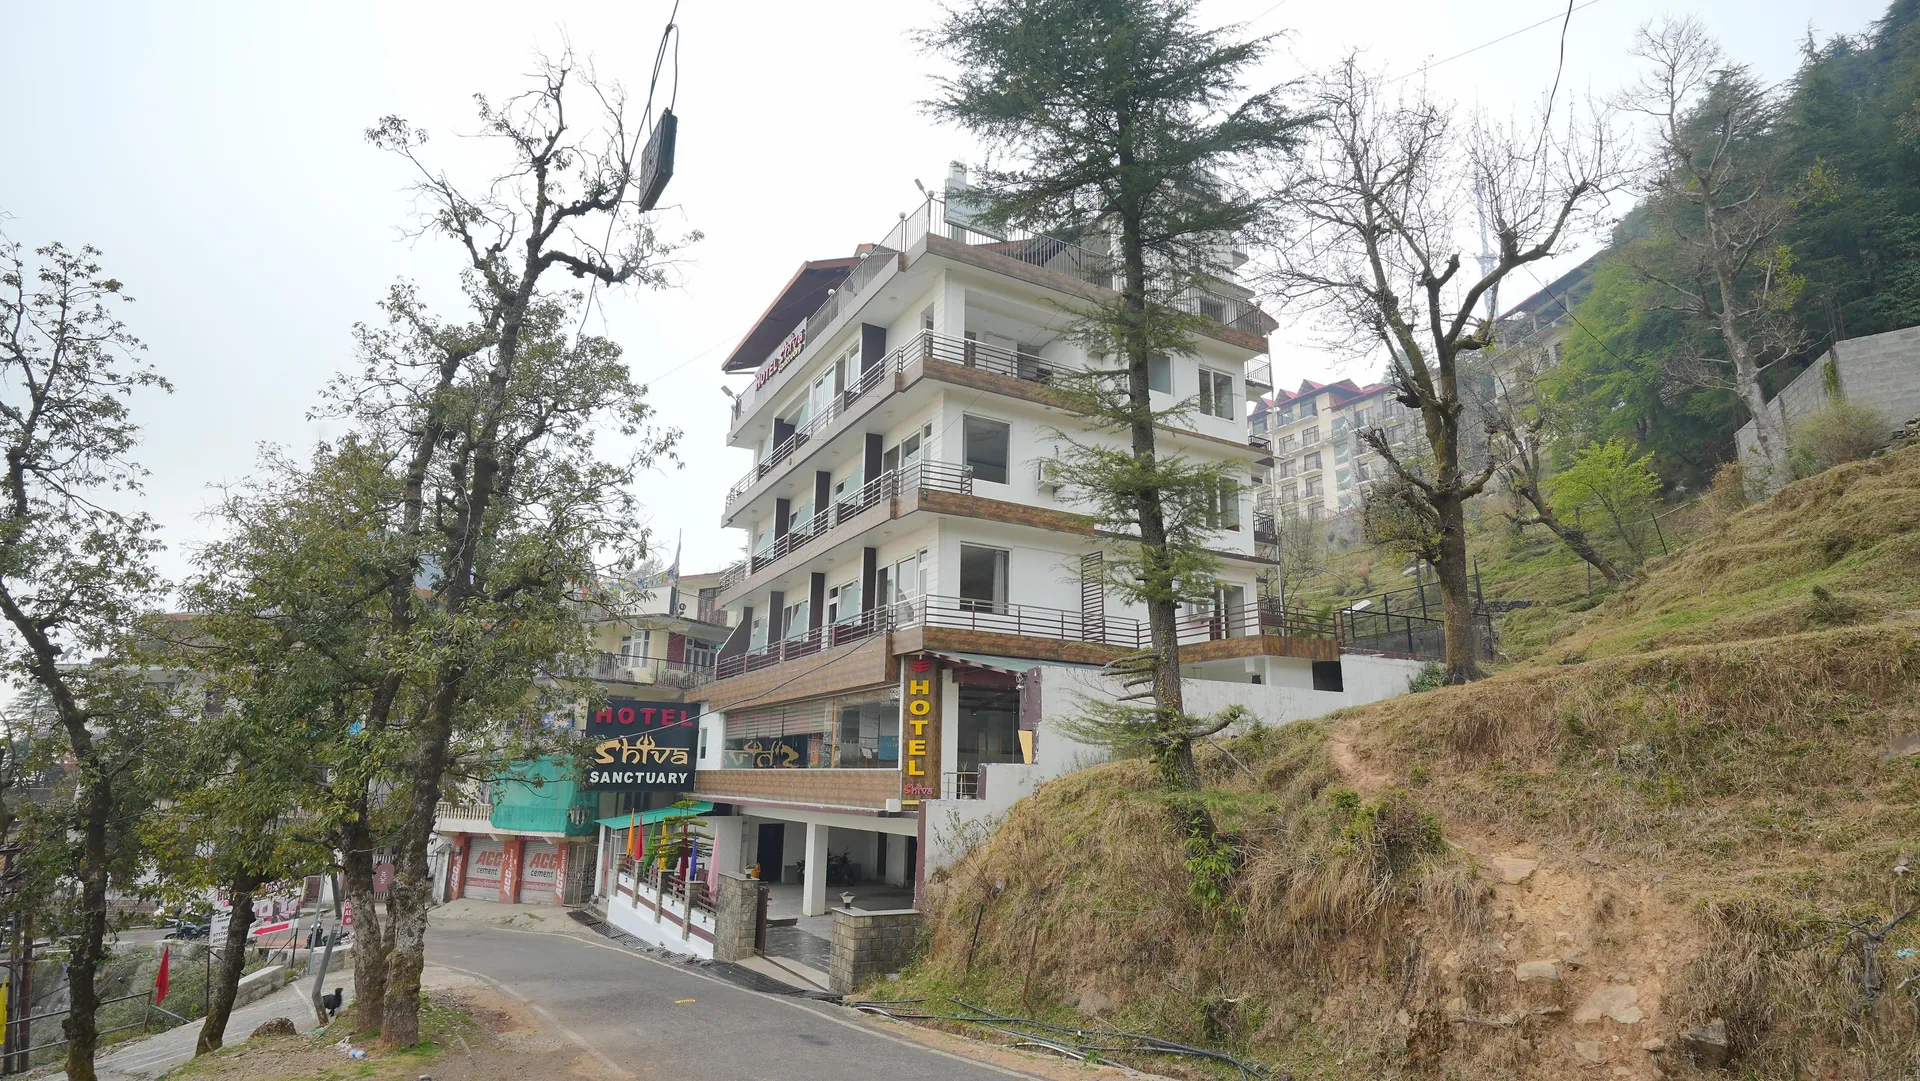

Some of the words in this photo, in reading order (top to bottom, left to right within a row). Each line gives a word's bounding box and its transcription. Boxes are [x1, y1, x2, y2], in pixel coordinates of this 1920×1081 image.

[756, 360, 778, 391] HOTEL
[595, 706, 694, 727] HOTEL
[908, 679, 931, 776] HOTEL
[594, 732, 690, 765] Shiva
[589, 771, 688, 784] SANCTUARY
[904, 783, 934, 795] Shiva
[475, 851, 504, 867] ACC
[529, 852, 558, 869] ACC
[451, 865, 460, 892] ACC
[476, 866, 498, 876] cement
[530, 869, 554, 878] cement
[504, 869, 512, 896] ACC
[555, 868, 564, 898] ACC
